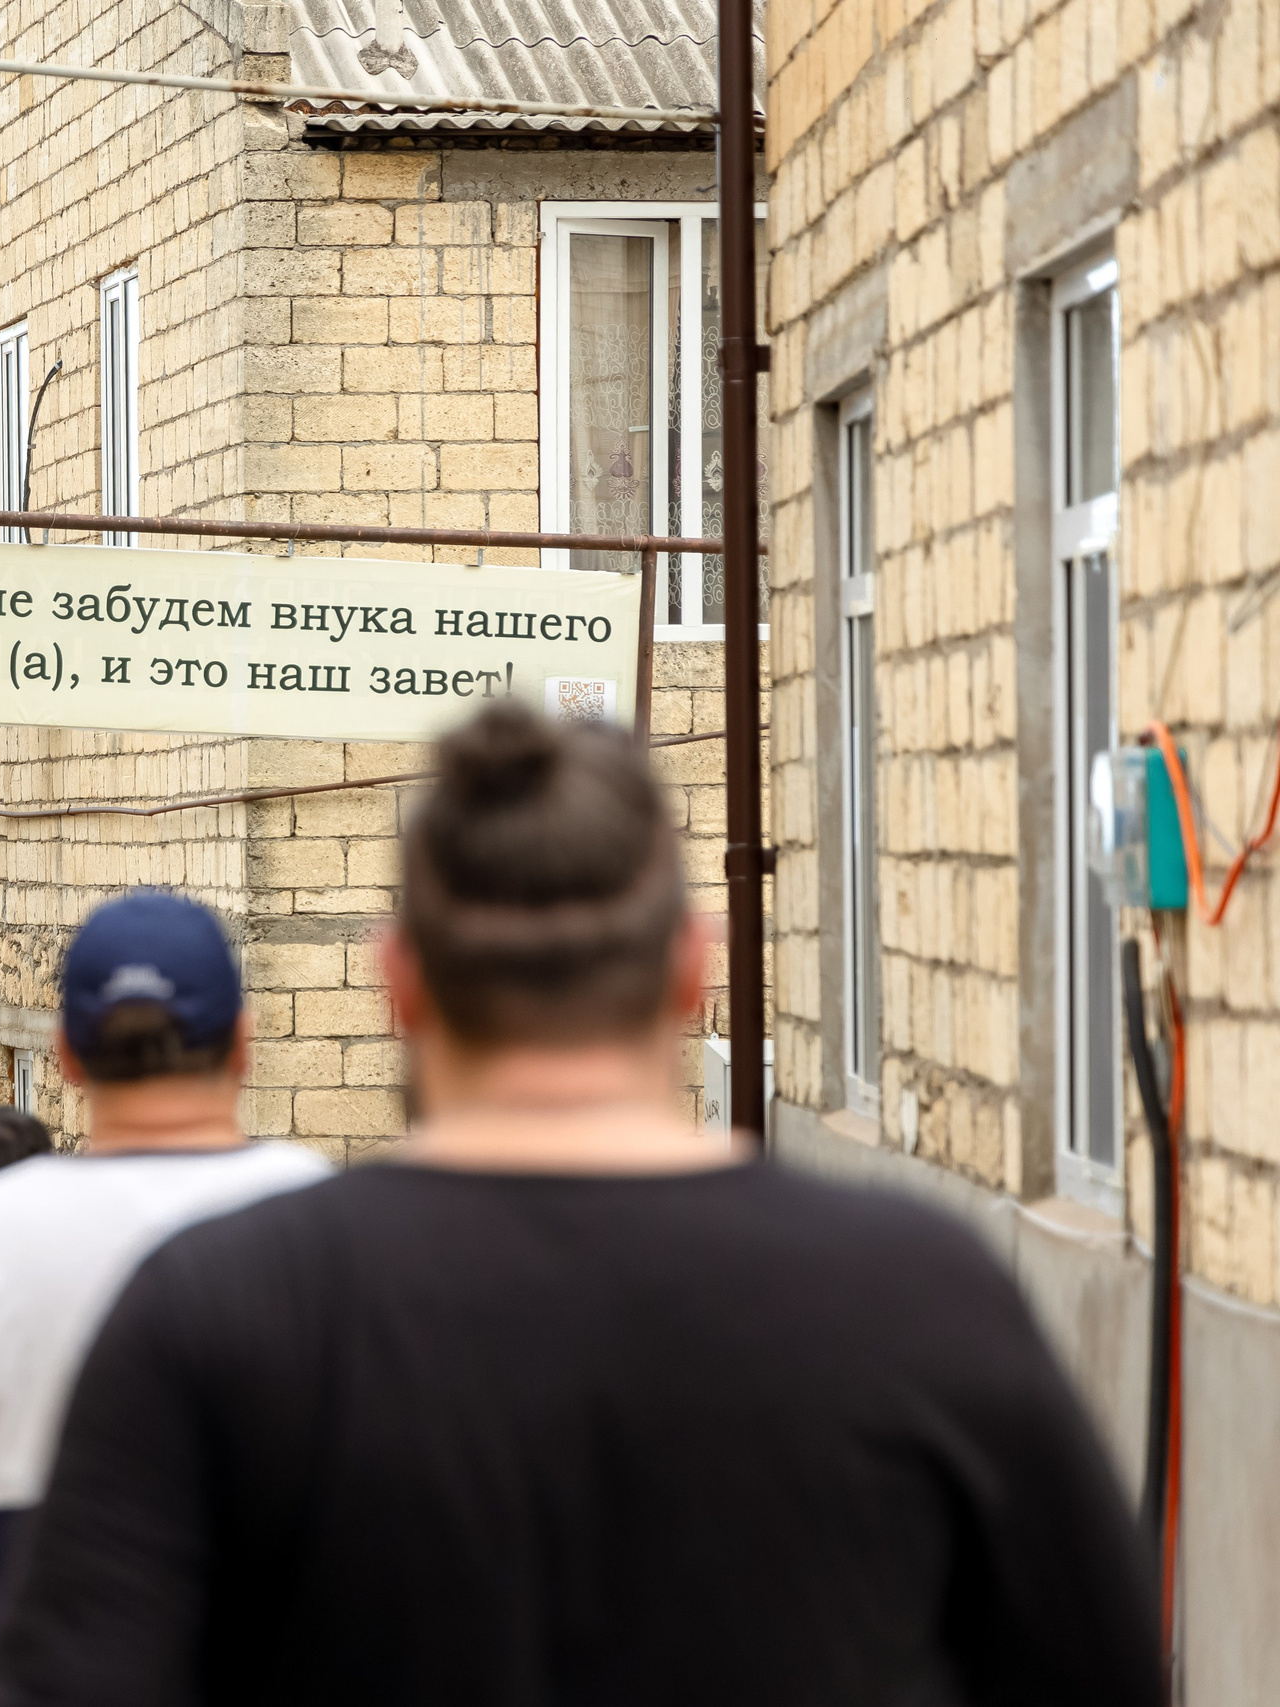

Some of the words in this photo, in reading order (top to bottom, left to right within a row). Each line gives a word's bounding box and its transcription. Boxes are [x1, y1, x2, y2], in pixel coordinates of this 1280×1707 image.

[51, 583, 252, 635] забудем
[270, 601, 417, 643] внука
[433, 607, 612, 643] нашего
[9, 640, 80, 692] (а),
[100, 654, 132, 684] и
[149, 656, 228, 688] это
[246, 661, 351, 693] наш
[368, 661, 514, 698] завет!
